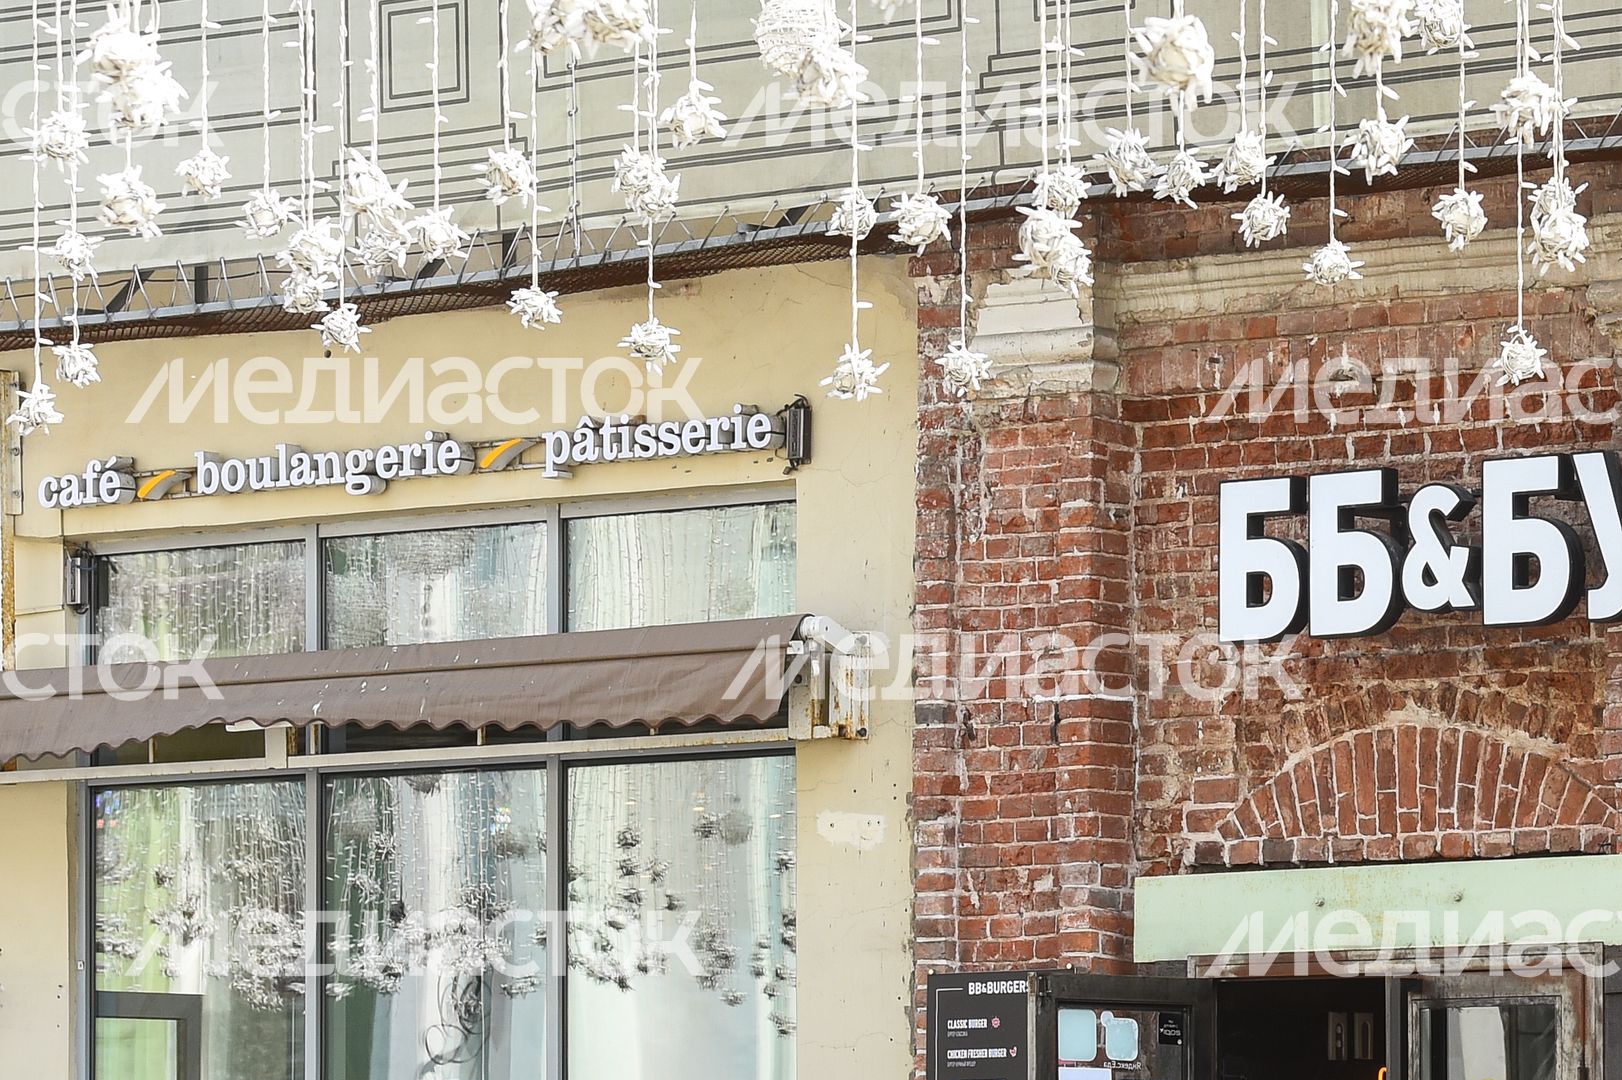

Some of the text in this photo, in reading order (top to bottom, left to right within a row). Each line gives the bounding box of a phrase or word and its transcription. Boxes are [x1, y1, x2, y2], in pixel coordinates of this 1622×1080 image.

[37, 403, 773, 509] café boulangerie pâtisserie
[947, 1018, 988, 1029] CLASSIC BURGER
